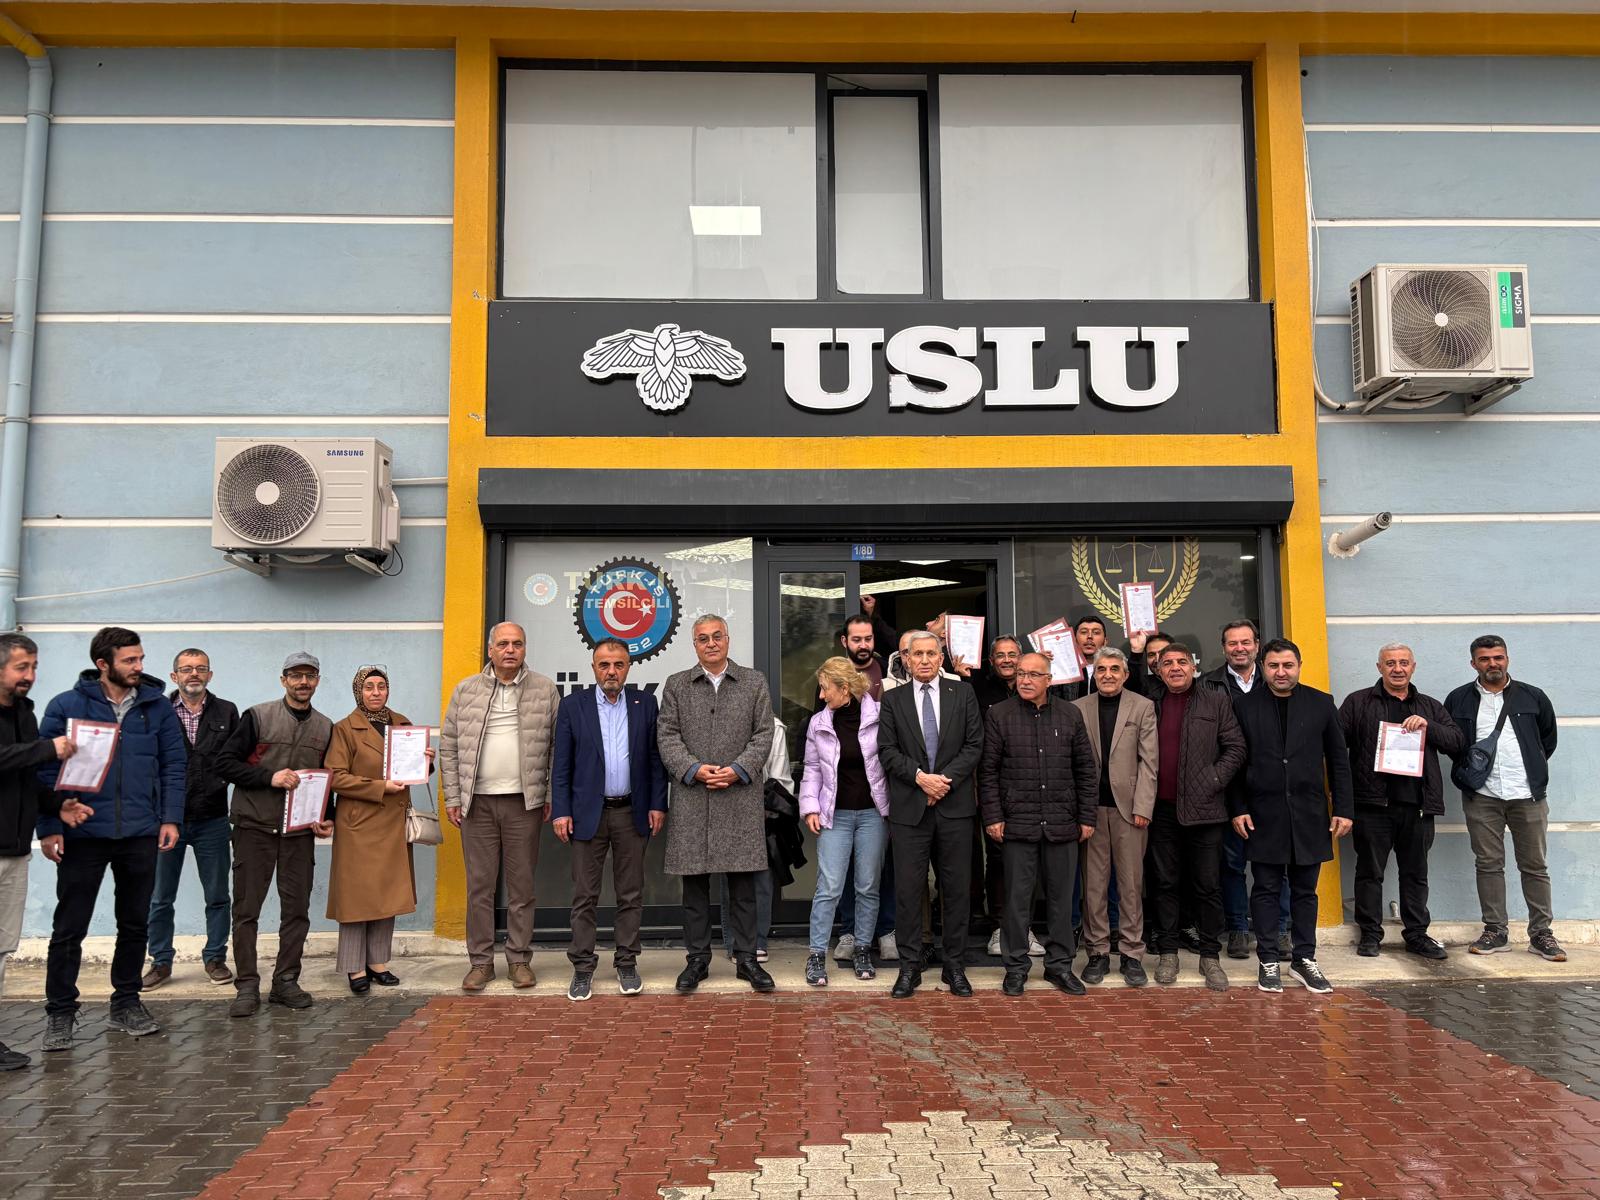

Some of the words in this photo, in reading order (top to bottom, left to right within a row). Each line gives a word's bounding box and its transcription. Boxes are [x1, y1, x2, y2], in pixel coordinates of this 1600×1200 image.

[1514, 285, 1523, 314] SIGMA
[771, 325, 1190, 410] USLU
[326, 449, 364, 457] SAMSUNG
[853, 545, 873, 556] 1/8D
[628, 636, 653, 653] 52
